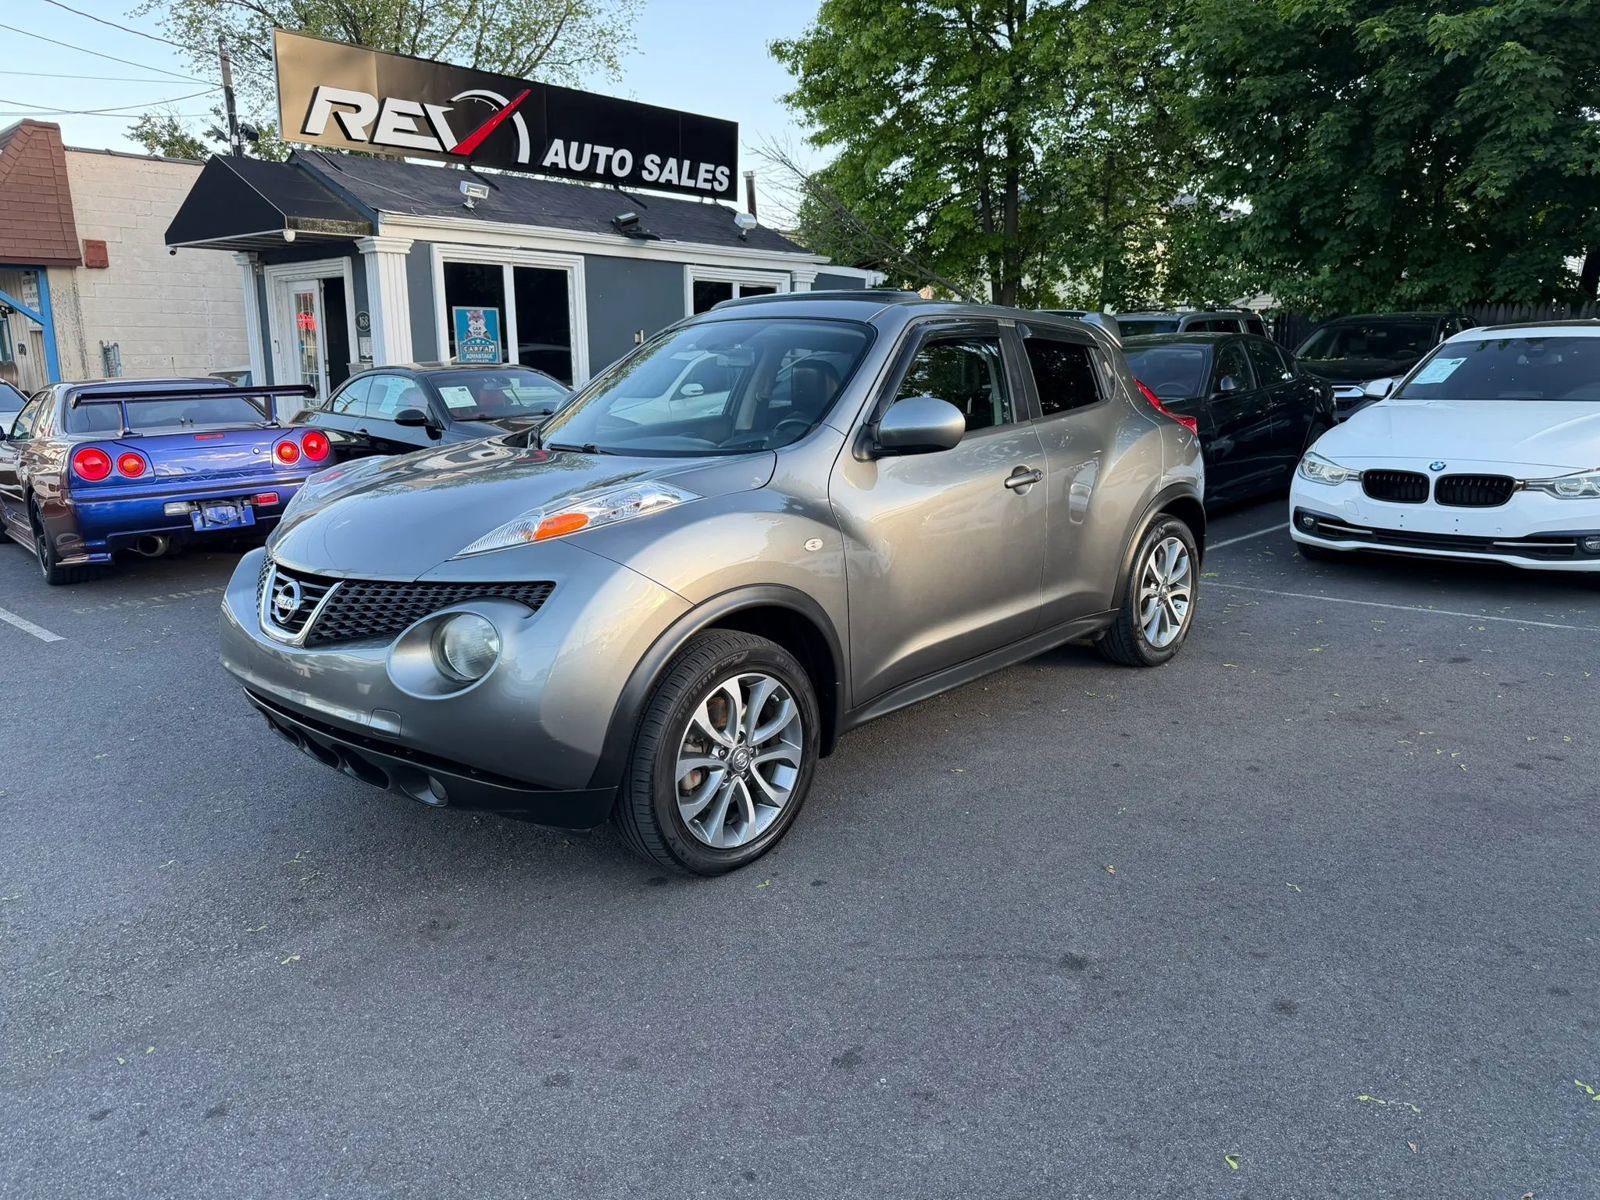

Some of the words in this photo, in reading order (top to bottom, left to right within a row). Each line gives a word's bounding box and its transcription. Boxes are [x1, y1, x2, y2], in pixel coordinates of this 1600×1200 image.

[302, 85, 532, 156] REV
[542, 138, 633, 178] AUTO
[641, 153, 731, 192] SALES
